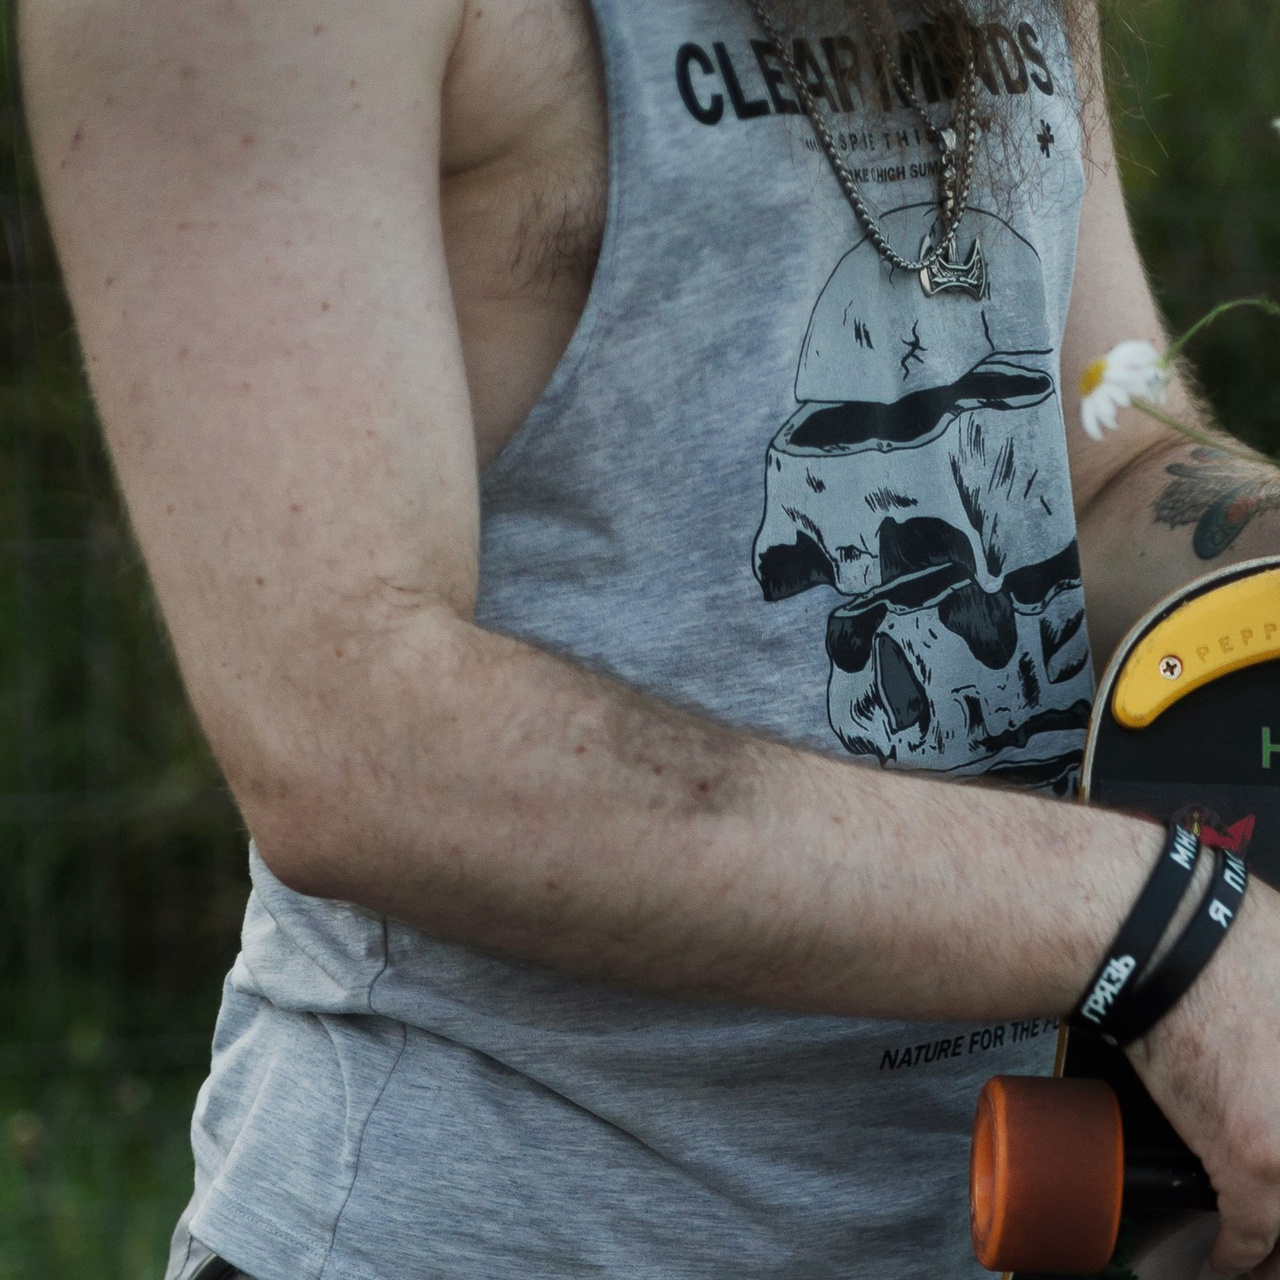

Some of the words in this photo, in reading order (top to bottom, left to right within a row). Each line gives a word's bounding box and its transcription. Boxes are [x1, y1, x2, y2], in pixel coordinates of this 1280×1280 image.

[1208, 898, 1234, 929] Я
[879, 1034, 967, 1070] NATURE
[968, 1023, 1005, 1053] FOR
[1010, 1019, 1040, 1044] THE
